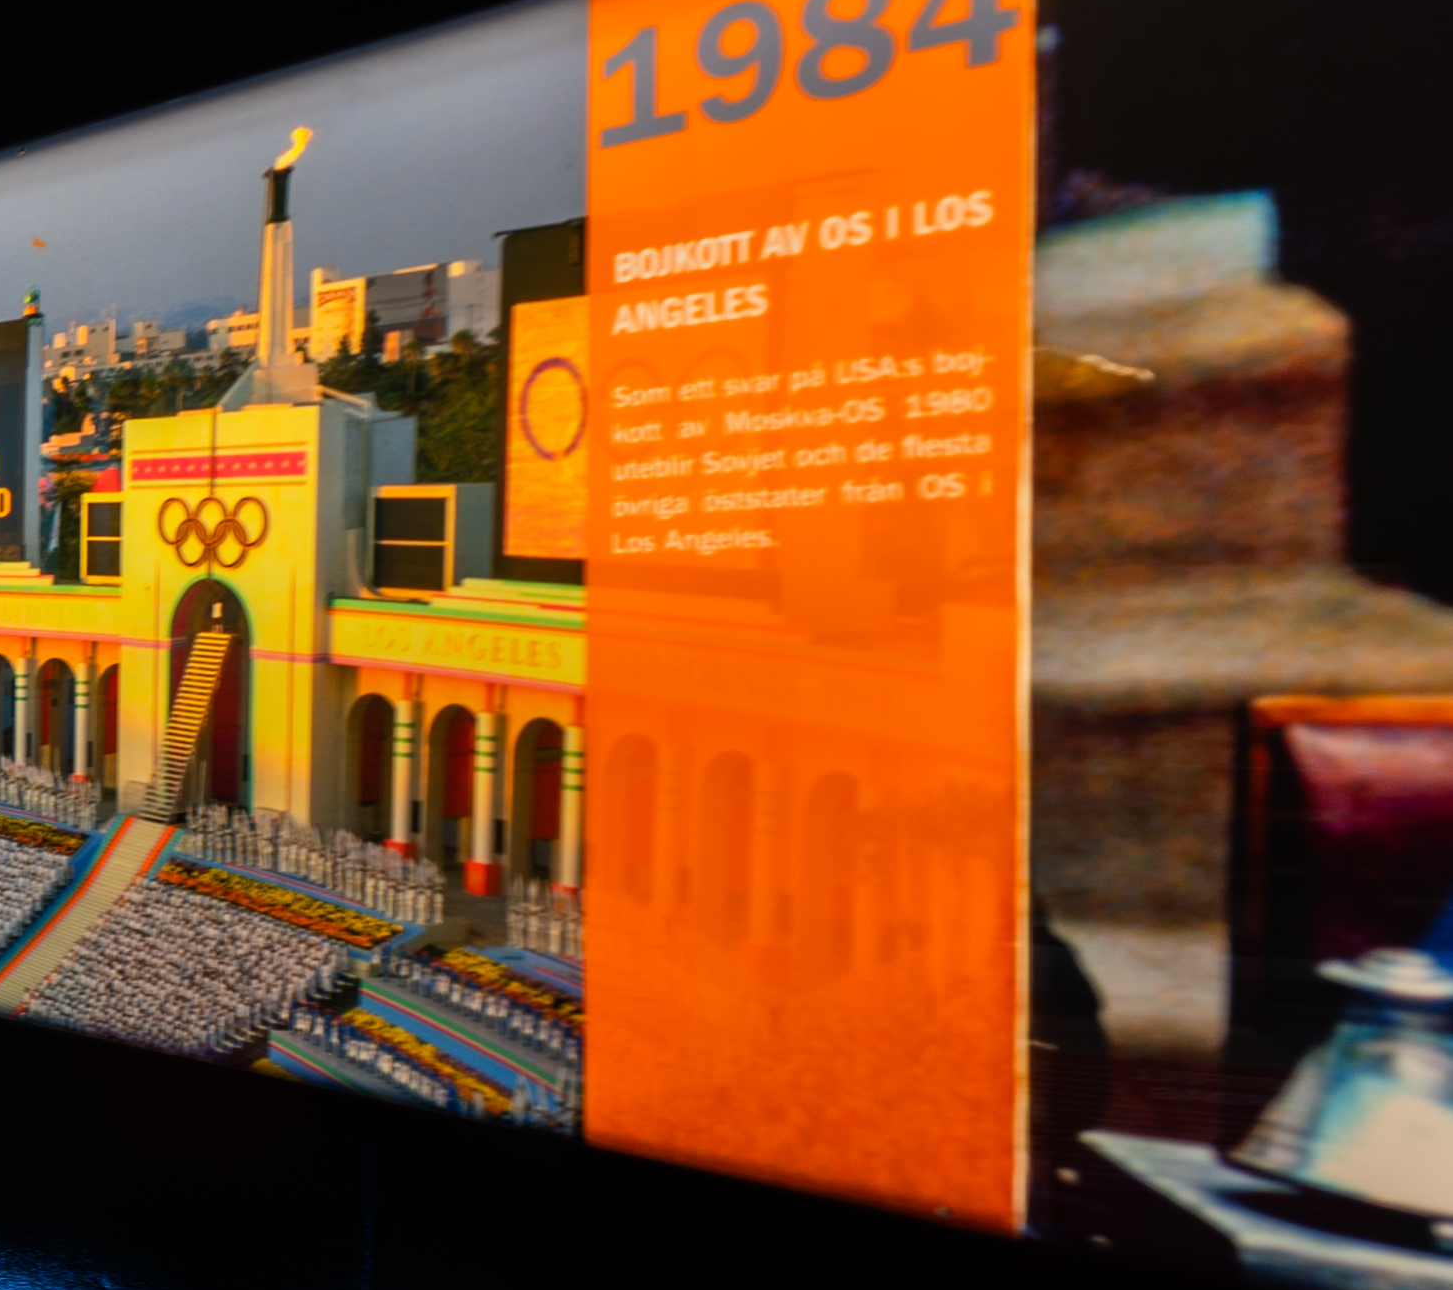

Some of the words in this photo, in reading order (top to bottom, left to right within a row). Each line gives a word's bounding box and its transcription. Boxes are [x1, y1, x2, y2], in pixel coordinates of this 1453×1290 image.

[613, 229, 754, 284] BOJKOTT
[759, 221, 808, 259] AV
[817, 209, 873, 250] OS
[884, 205, 899, 239] I
[912, 189, 994, 236] LOS
[611, 283, 768, 335] ANGELES
[612, 384, 671, 409] Som
[677, 377, 715, 402] ett
[722, 372, 781, 397] svar
[788, 363, 826, 393] på
[611, 418, 663, 444] kott
[677, 419, 707, 440] av
[905, 385, 993, 420] 1980
[612, 452, 694, 481] uteblir
[700, 447, 786, 477] Sovjet
[793, 441, 847, 468] och
[854, 438, 894, 464] de
[900, 432, 992, 459] flesta
[611, 494, 690, 521] övriga
[702, 485, 827, 513] öststater
[840, 476, 904, 504] från
[918, 470, 966, 501] OS
[611, 531, 656, 554] Los
[422, 629, 564, 669] ANGELES
